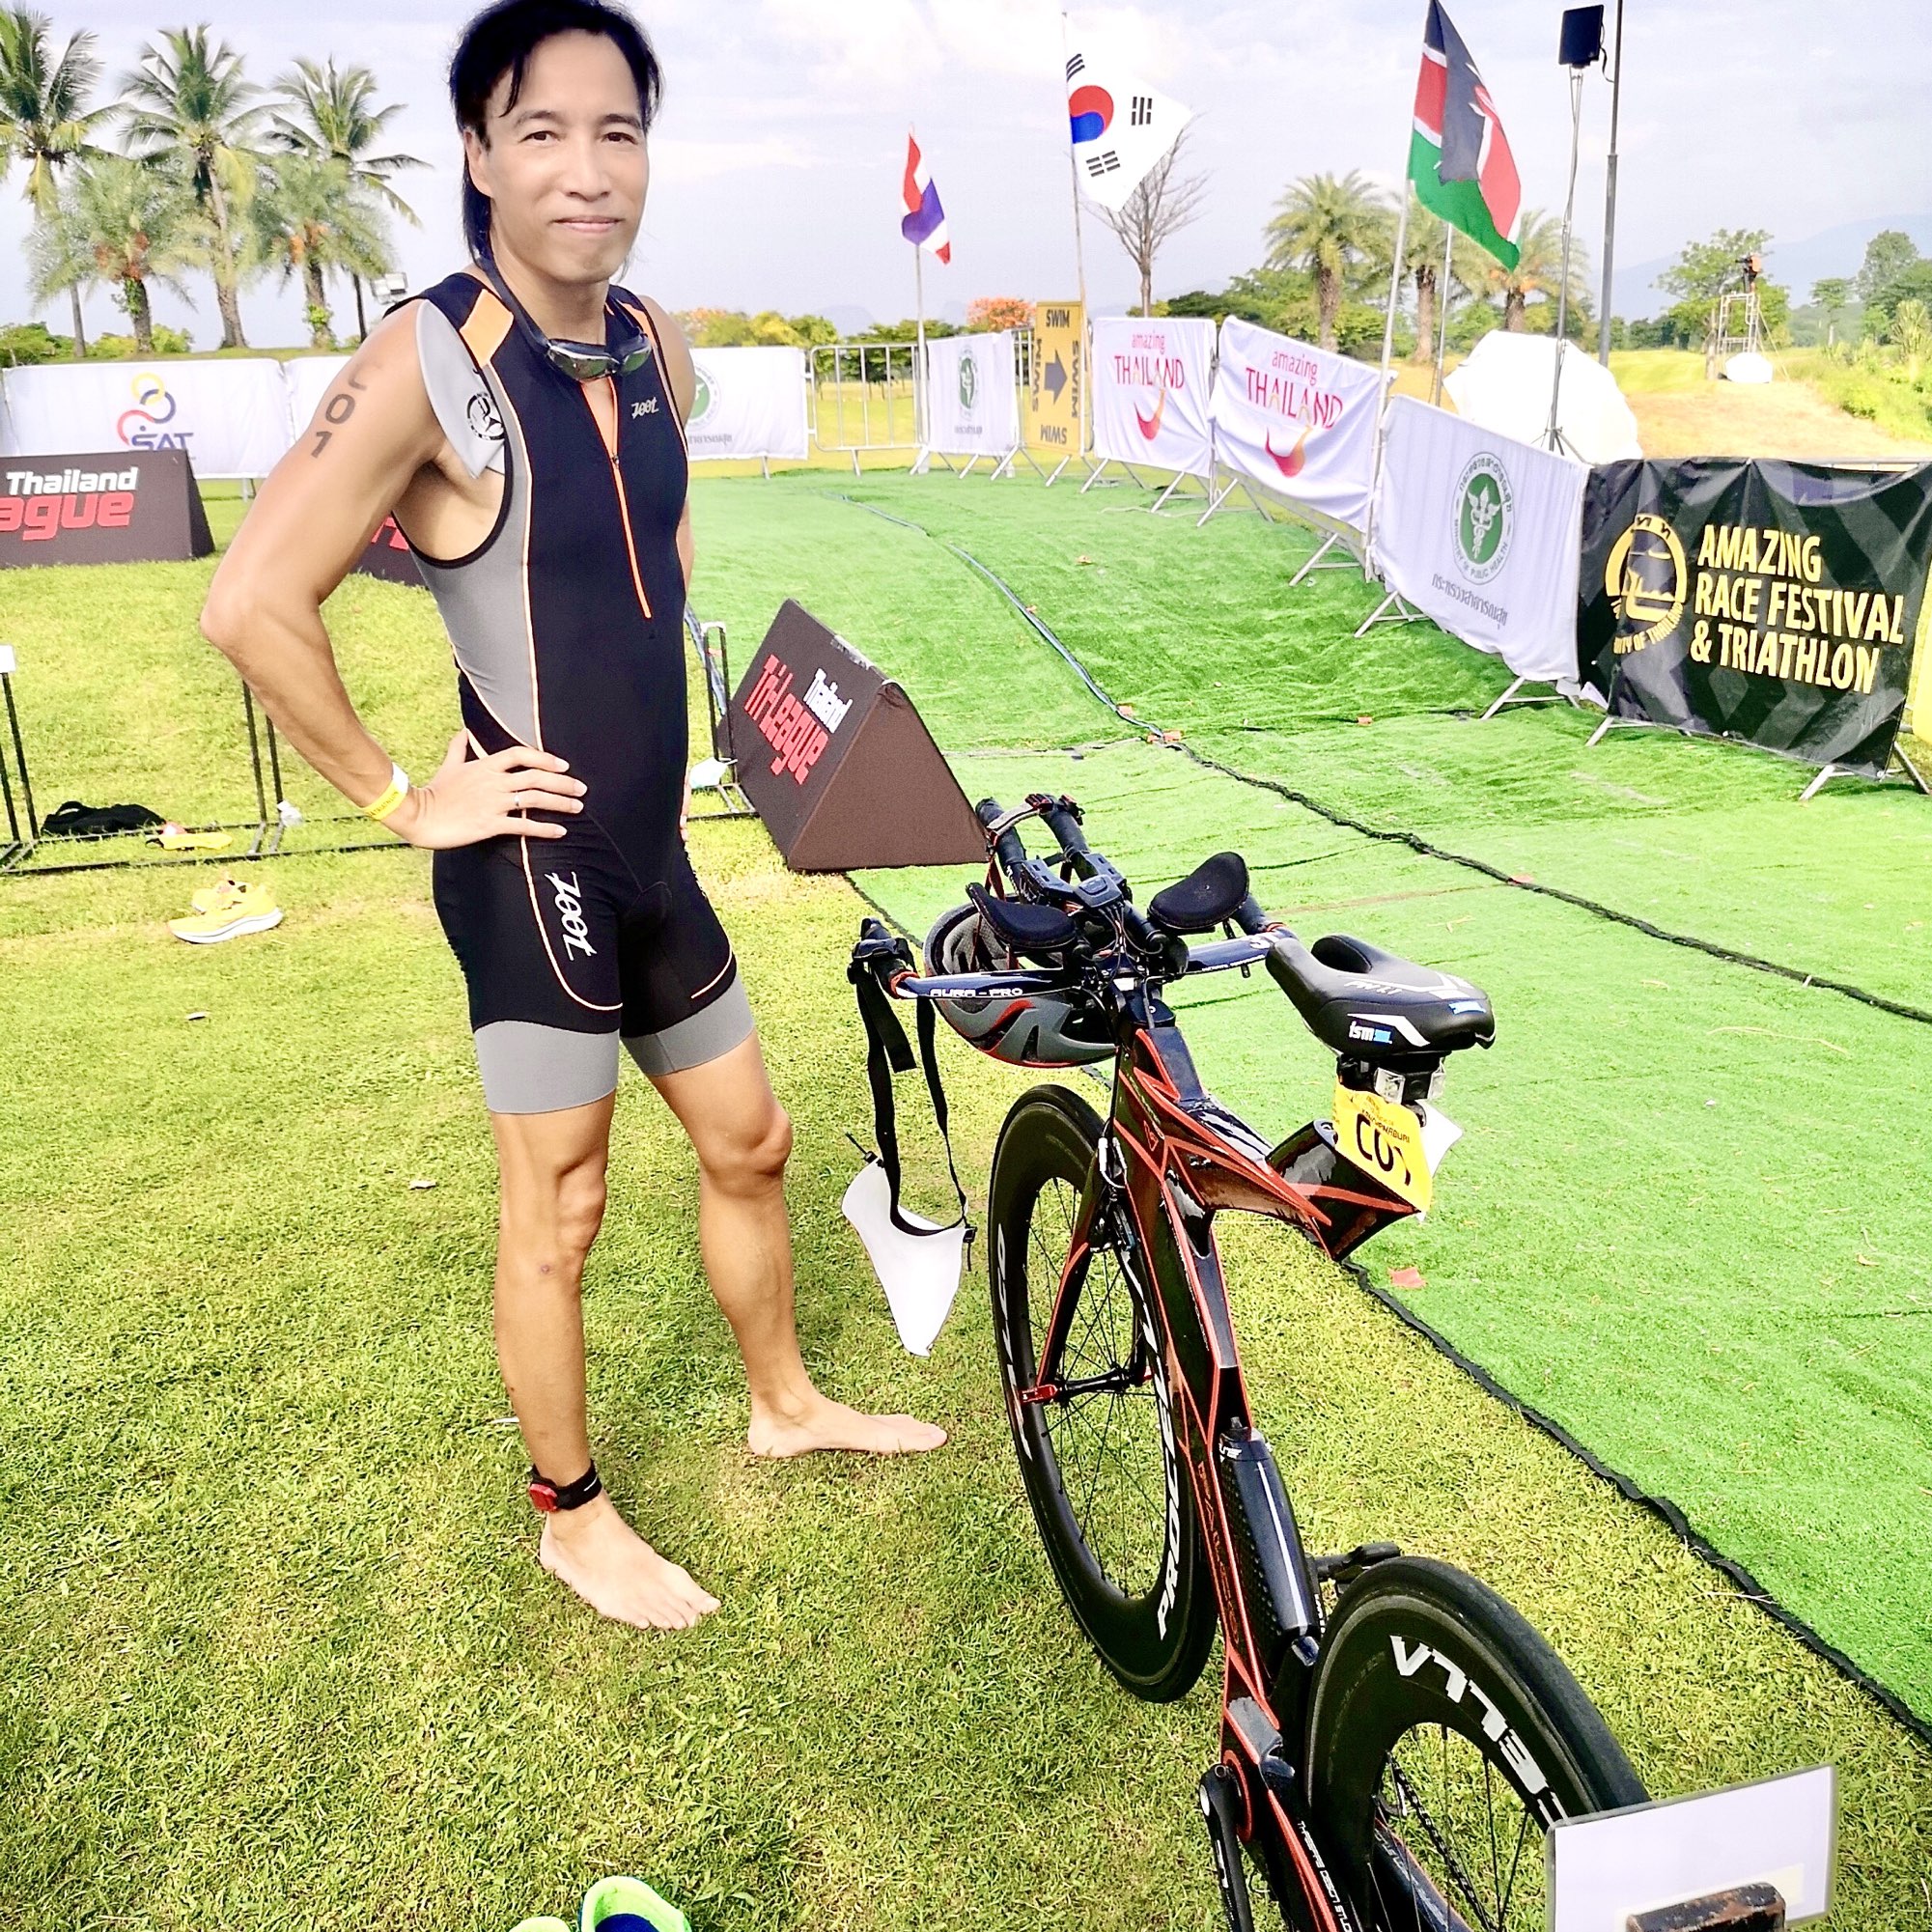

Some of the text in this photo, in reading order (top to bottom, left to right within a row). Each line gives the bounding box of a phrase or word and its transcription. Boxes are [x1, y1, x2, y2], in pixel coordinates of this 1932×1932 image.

[1046, 309, 1070, 329] SWIM
[1133, 330, 1164, 354] amazing
[1032, 338, 1042, 412] SWIM
[1072, 341, 1080, 418] SWIM
[1114, 355, 1185, 389] THAILAND
[1272, 350, 1318, 386] amazing
[1246, 367, 1343, 430] THAILAND
[131, 432, 194, 451] SAT
[1040, 425, 1068, 445] SWIM
[6, 467, 139, 496] Thailand
[1697, 524, 1822, 582] AMAZING
[1694, 572, 1905, 645] RACE FESTIVAL
[1690, 619, 1880, 694] & TRIATHLON
